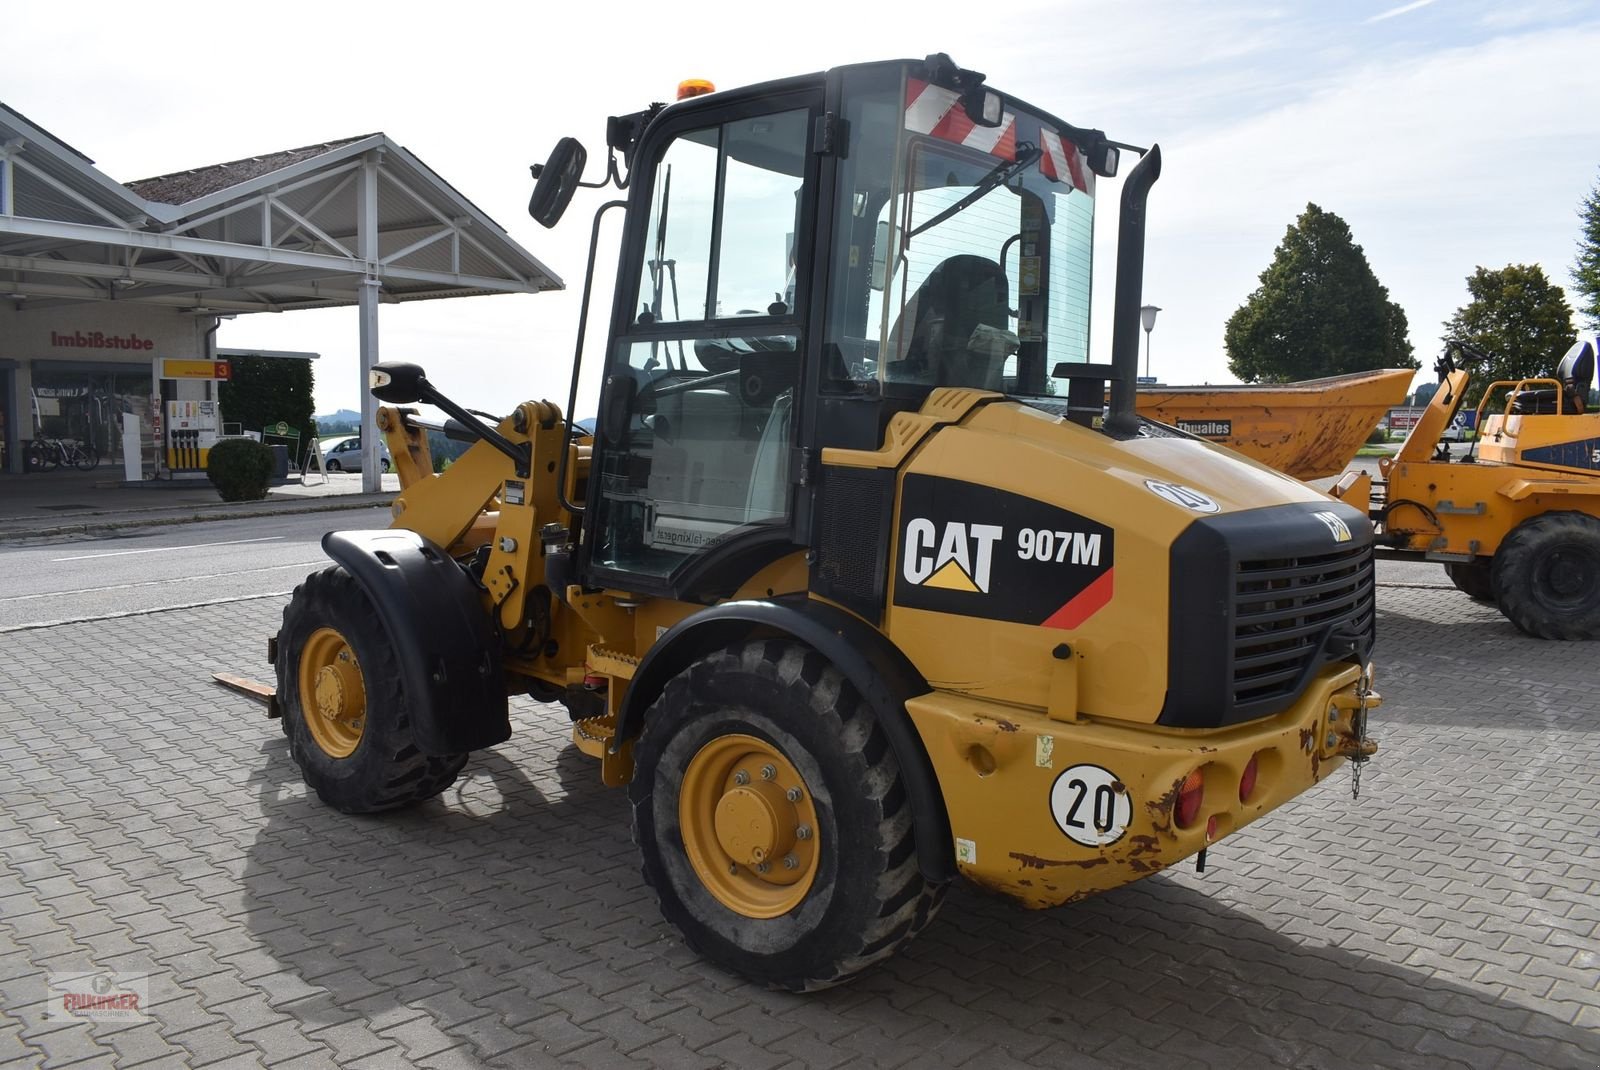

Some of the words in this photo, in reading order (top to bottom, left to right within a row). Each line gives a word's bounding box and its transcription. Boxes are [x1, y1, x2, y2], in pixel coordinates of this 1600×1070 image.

[51, 331, 154, 350] Imbißstube
[219, 365, 227, 376] 3
[1177, 422, 1230, 434] Thwaites
[903, 517, 1003, 594] CAT
[1017, 528, 1102, 567] 907M
[1066, 779, 1116, 833] 20
